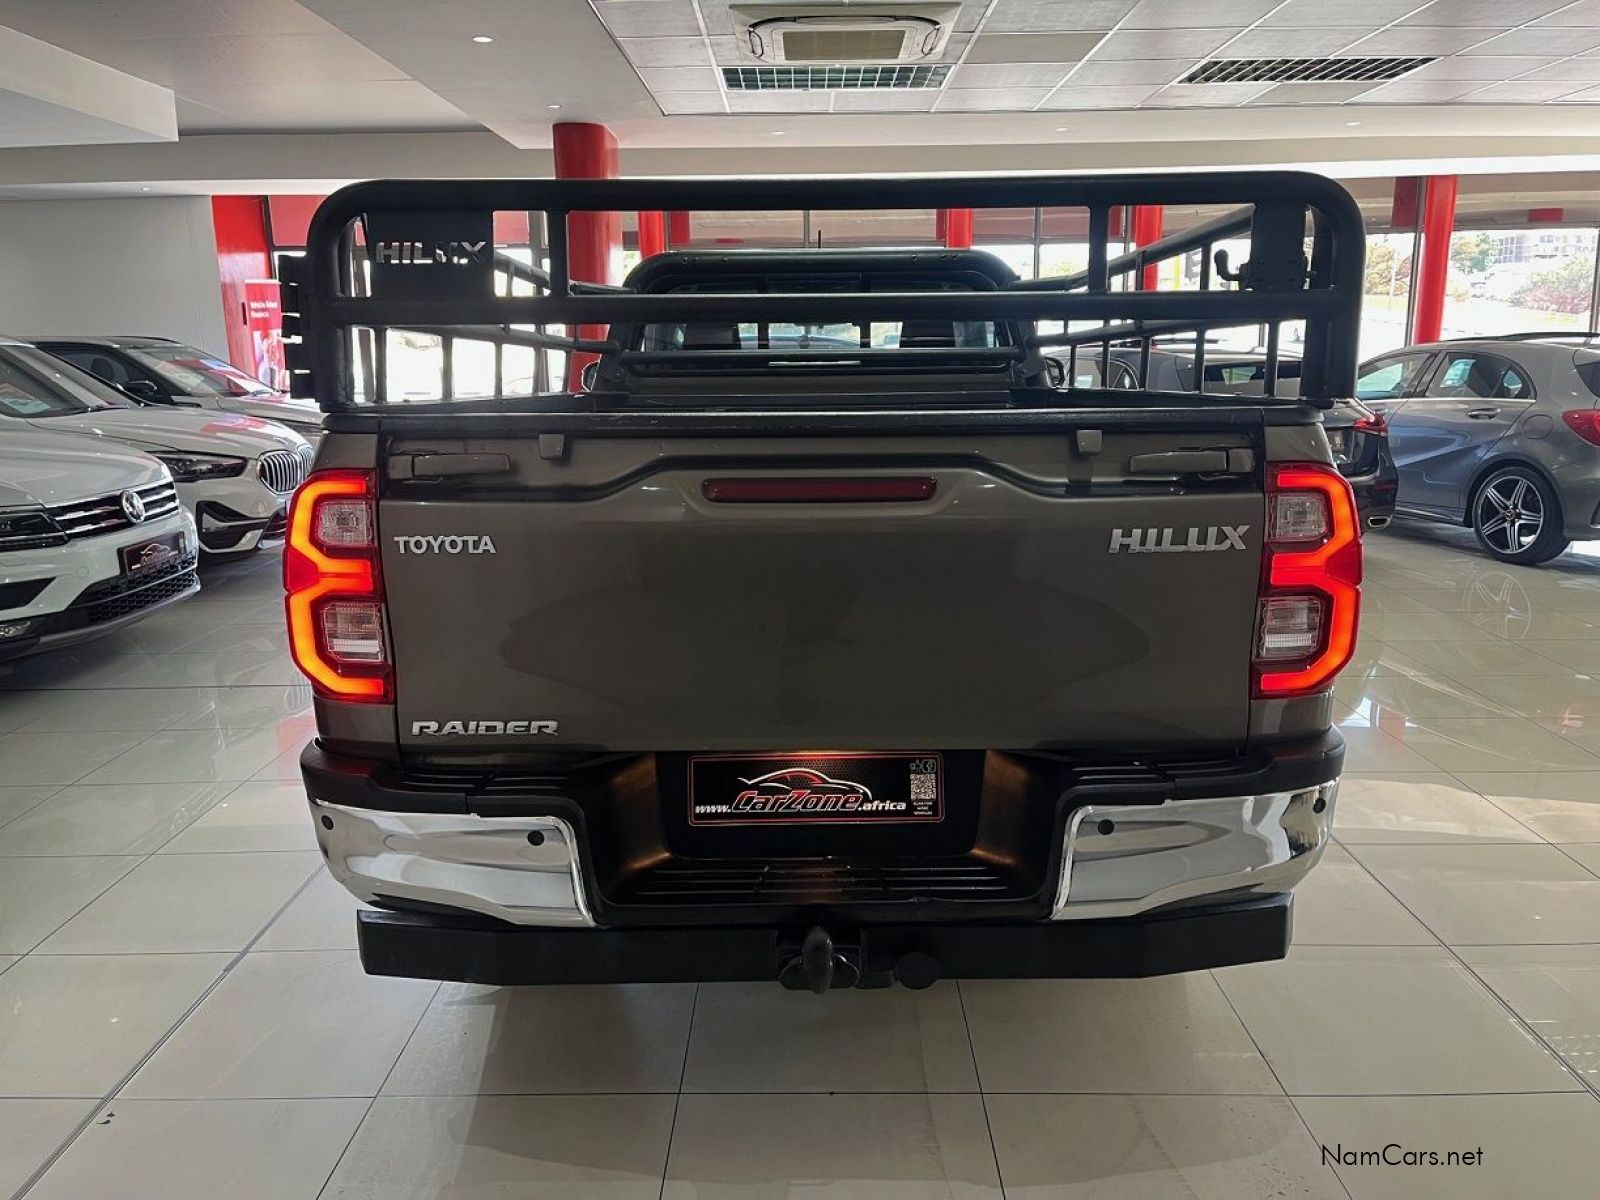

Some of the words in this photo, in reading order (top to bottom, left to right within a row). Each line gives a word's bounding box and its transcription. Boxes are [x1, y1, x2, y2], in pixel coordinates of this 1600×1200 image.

[393, 535, 497, 554] TOYOTA
[1108, 525, 1250, 553] HILUX
[411, 720, 560, 736] RAIDER
